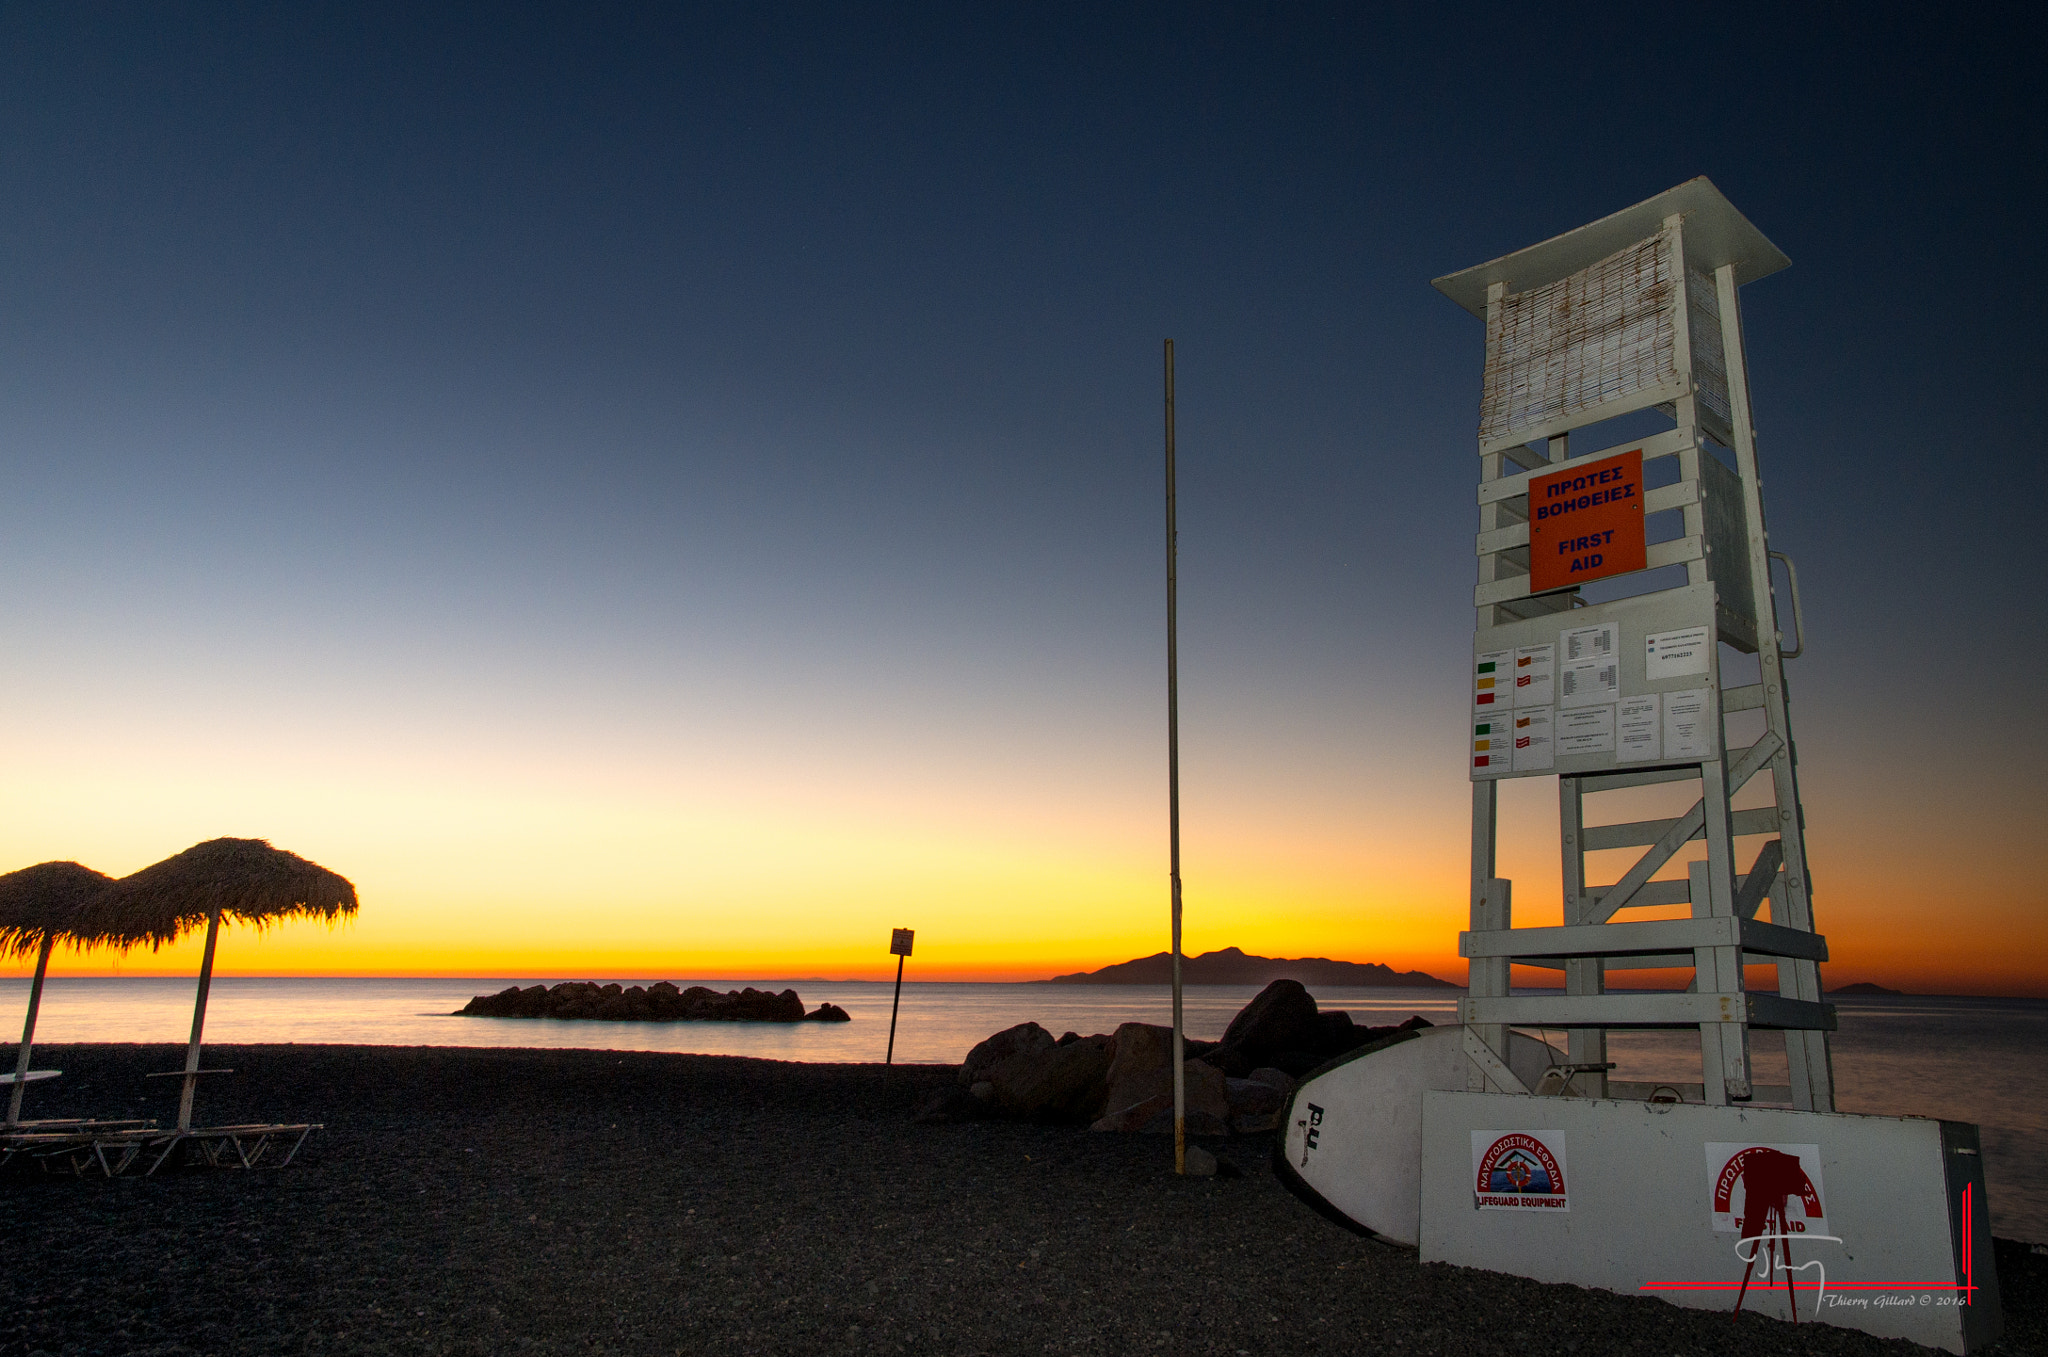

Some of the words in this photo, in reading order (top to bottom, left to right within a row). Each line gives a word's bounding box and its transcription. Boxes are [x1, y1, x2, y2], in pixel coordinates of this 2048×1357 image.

[1547, 466, 1623, 498] ΠΡΩΤΕΣ
[1537, 483, 1635, 520] ΒΟΗΘΕΙΕΣ
[1558, 529, 1614, 555] FIRST
[1569, 553, 1603, 573] AID
[1480, 1136, 1535, 1188] ΝΑΥΑΓΟΣΩΣΤΙΚΑ
[1536, 1146, 1561, 1190] ΕΦΟΔΙΑ
[1718, 1150, 1751, 1200] ΠΡΩΤΕ
[1477, 1196, 1520, 1207] LIFEGUARD
[1521, 1197, 1567, 1208] EQUIPMENT
